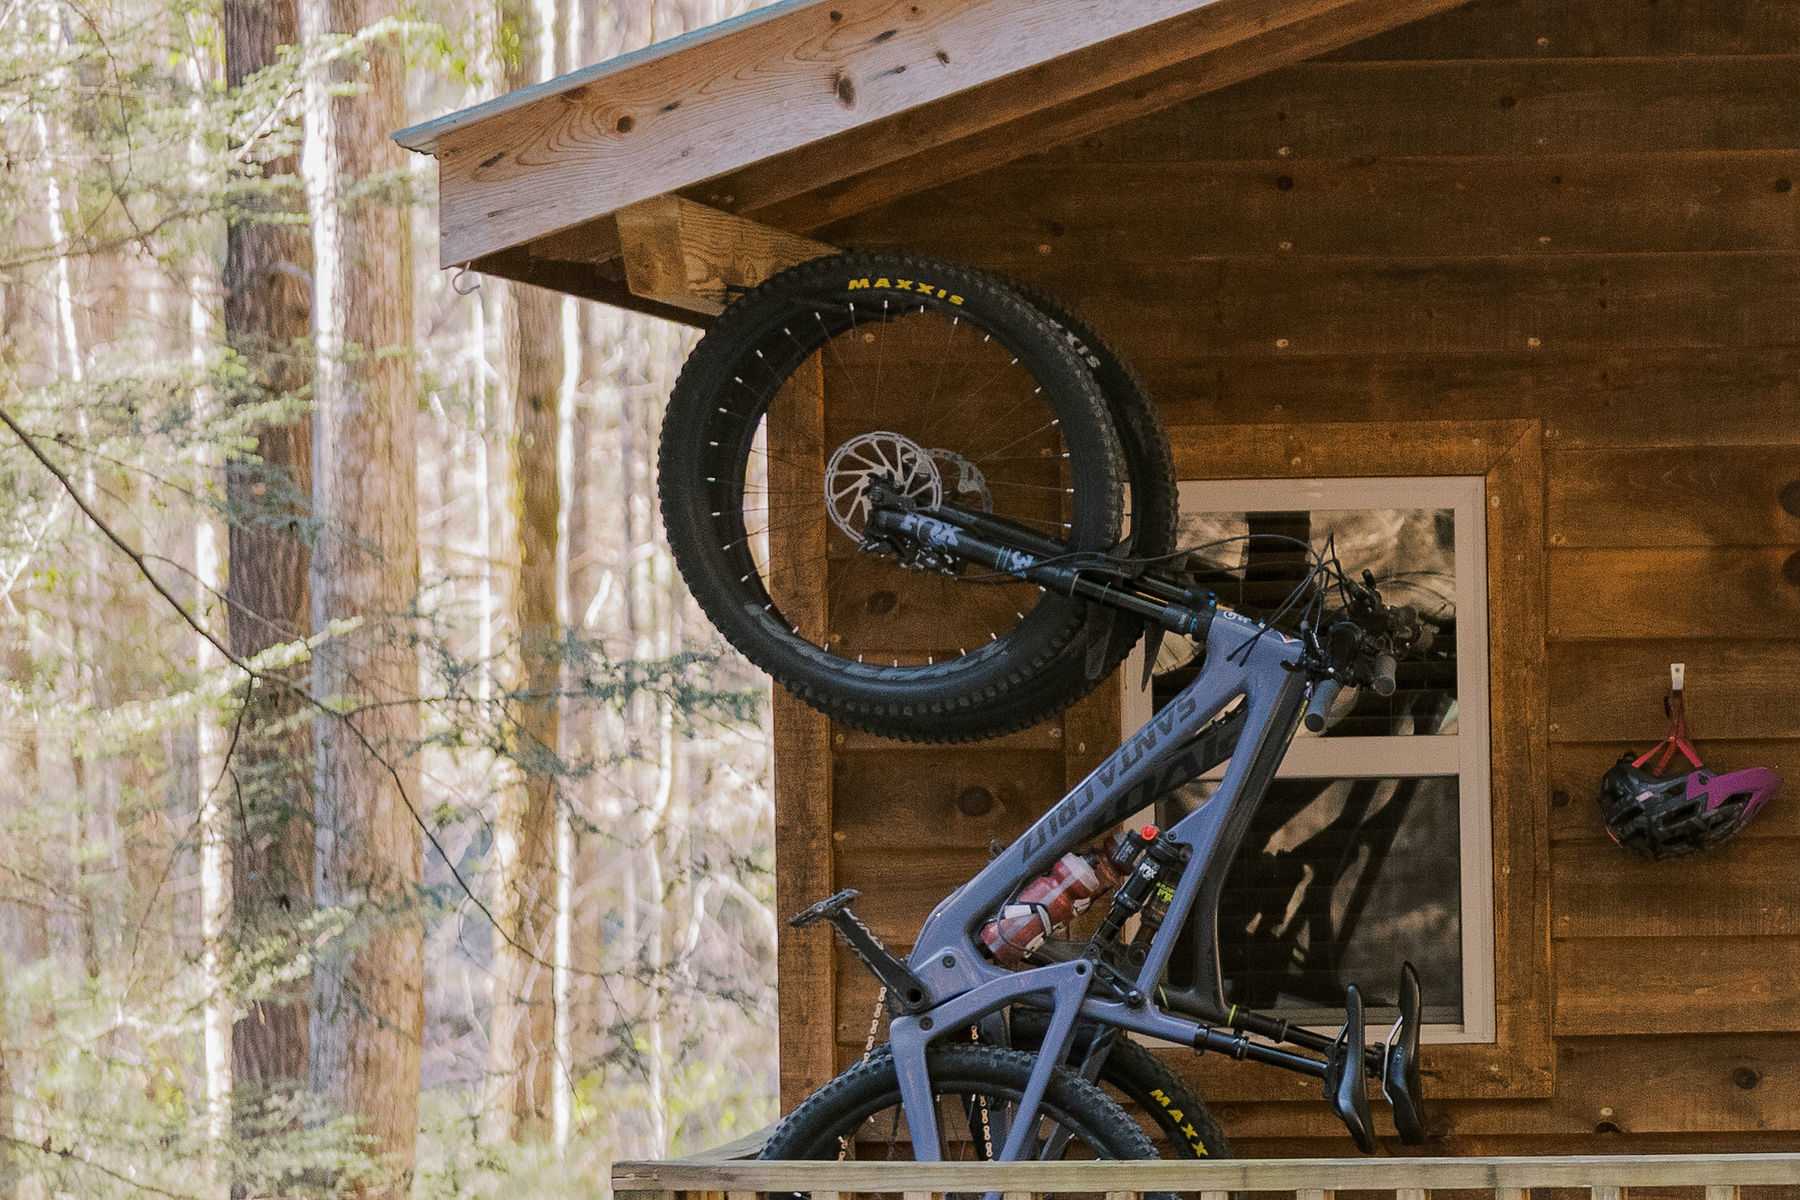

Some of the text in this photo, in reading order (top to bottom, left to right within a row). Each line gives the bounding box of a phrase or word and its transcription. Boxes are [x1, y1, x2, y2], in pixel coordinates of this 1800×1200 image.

[847, 277, 965, 306] MAXXIS
[1022, 697, 1197, 864] SANTA CRUZ
[1150, 1089, 1209, 1158] MAXX
